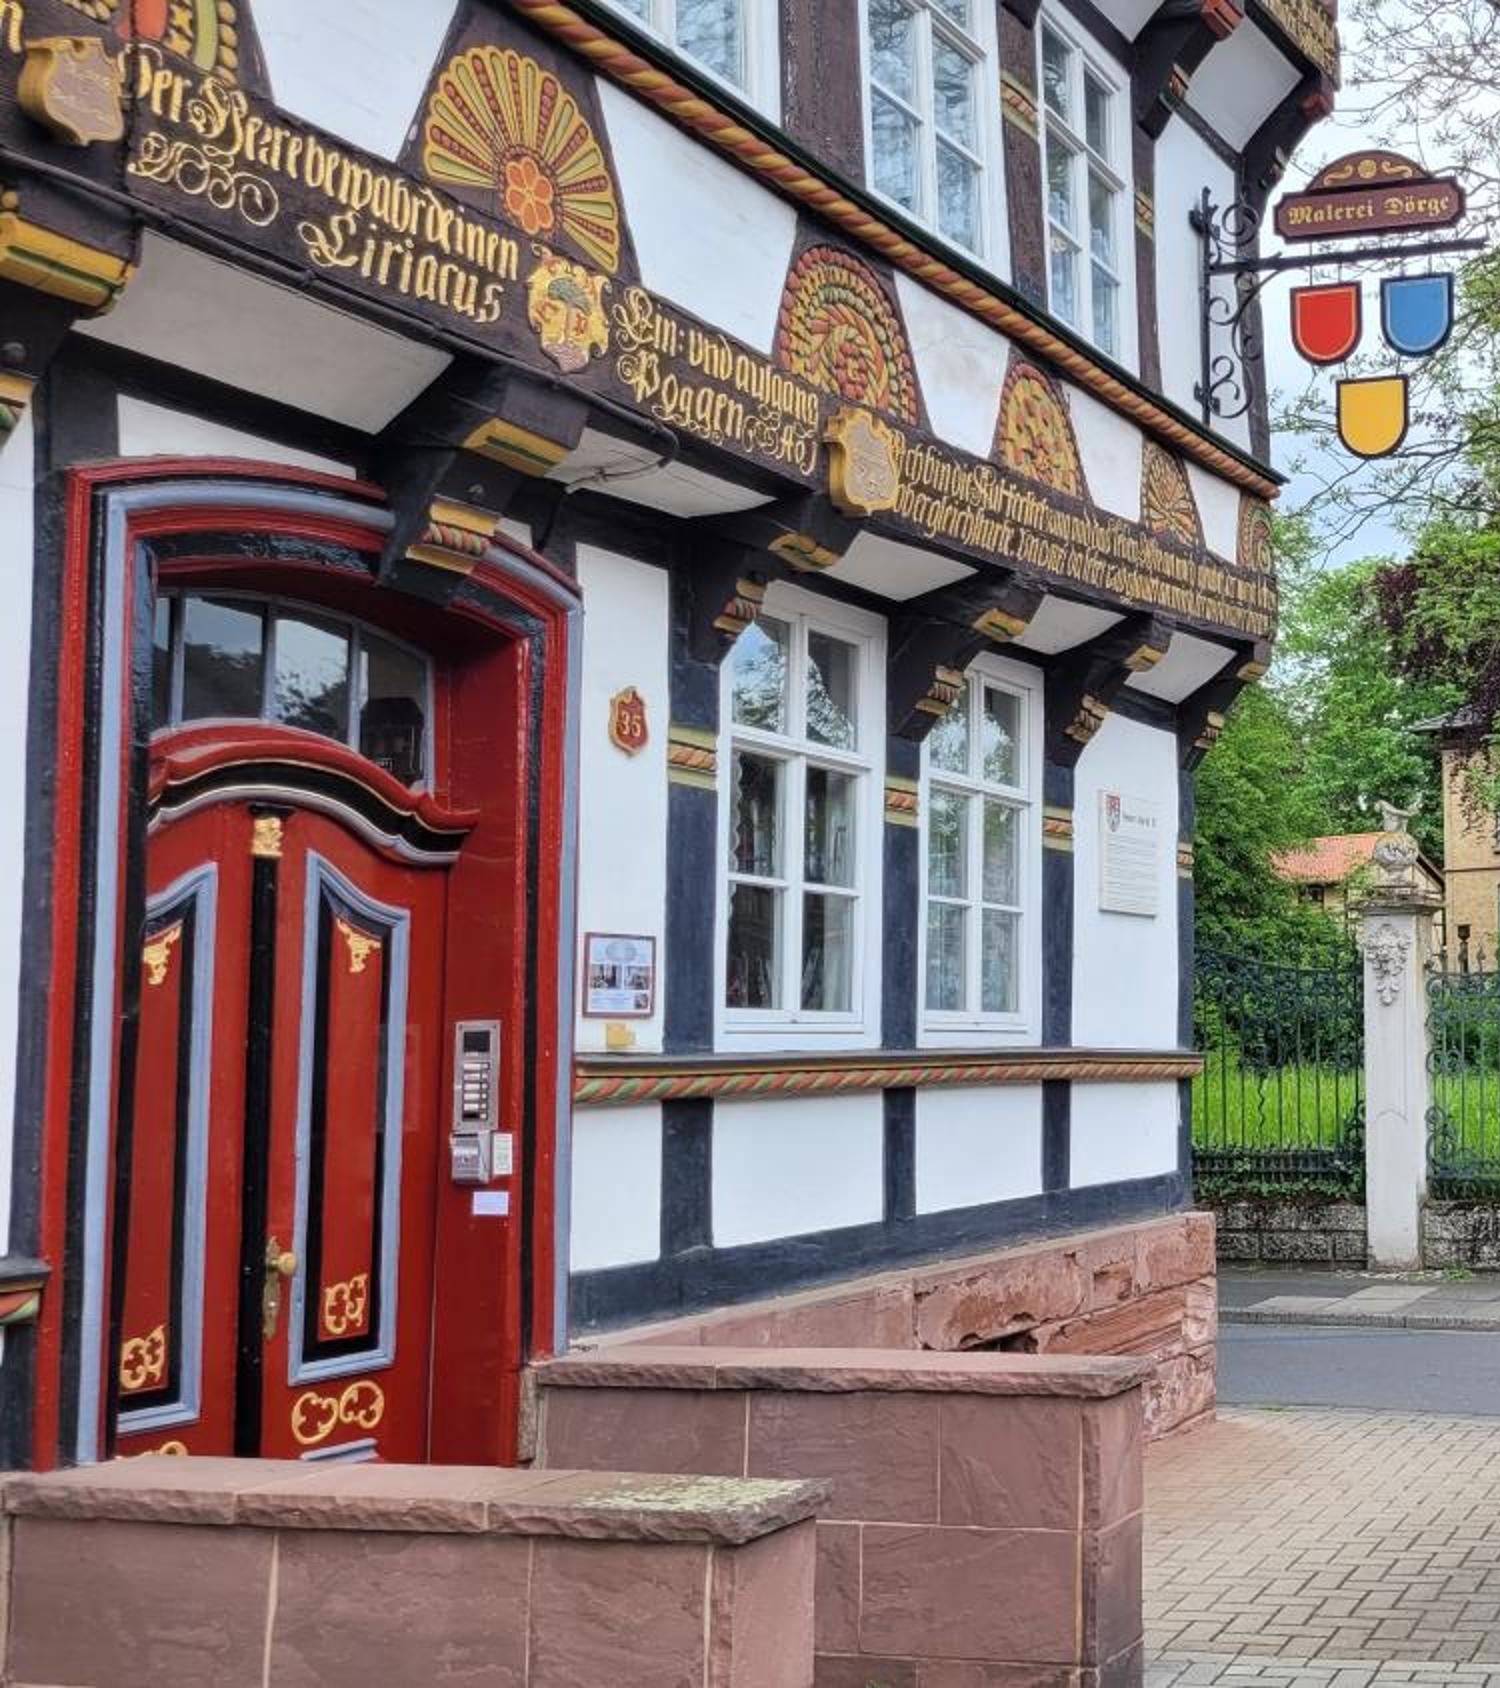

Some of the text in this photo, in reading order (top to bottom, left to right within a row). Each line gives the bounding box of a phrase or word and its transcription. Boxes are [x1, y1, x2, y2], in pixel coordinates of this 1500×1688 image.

[1288, 194, 1450, 226] Malerei Dörge
[616, 710, 641, 737] 35
